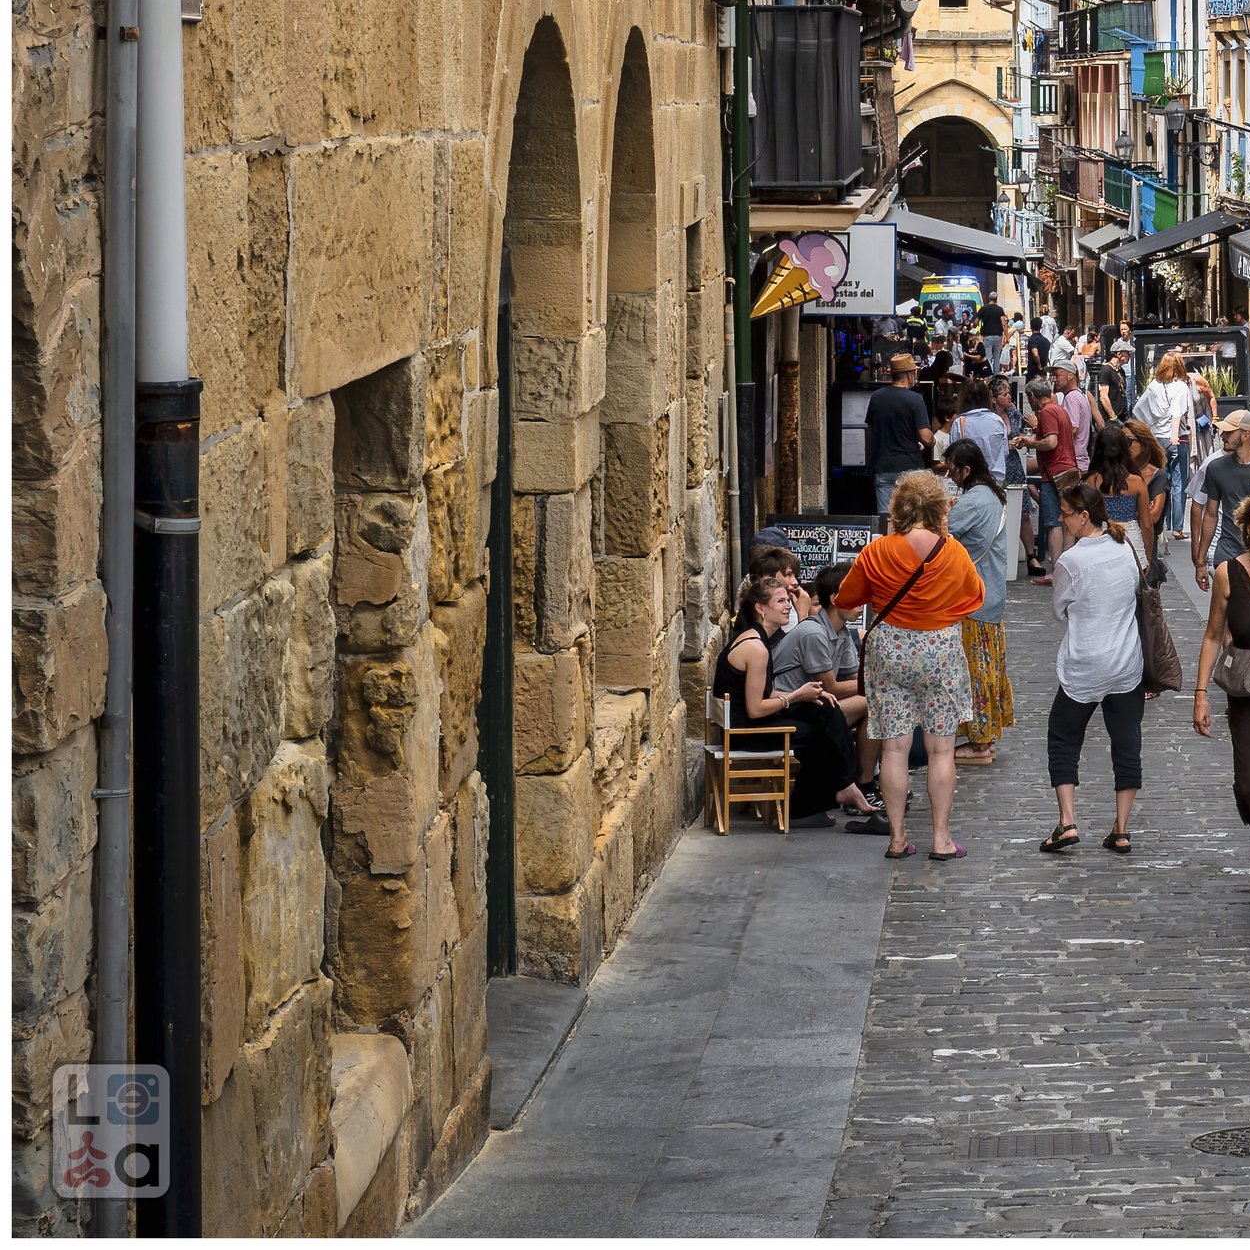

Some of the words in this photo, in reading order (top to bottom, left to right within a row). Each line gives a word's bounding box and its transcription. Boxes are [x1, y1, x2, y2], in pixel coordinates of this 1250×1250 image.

[854, 280, 860, 289] y
[860, 289, 874, 298] del
[787, 529, 819, 539] HELADOS
[839, 530, 867, 539] SABORES
[808, 553, 829, 561] DIARIA
